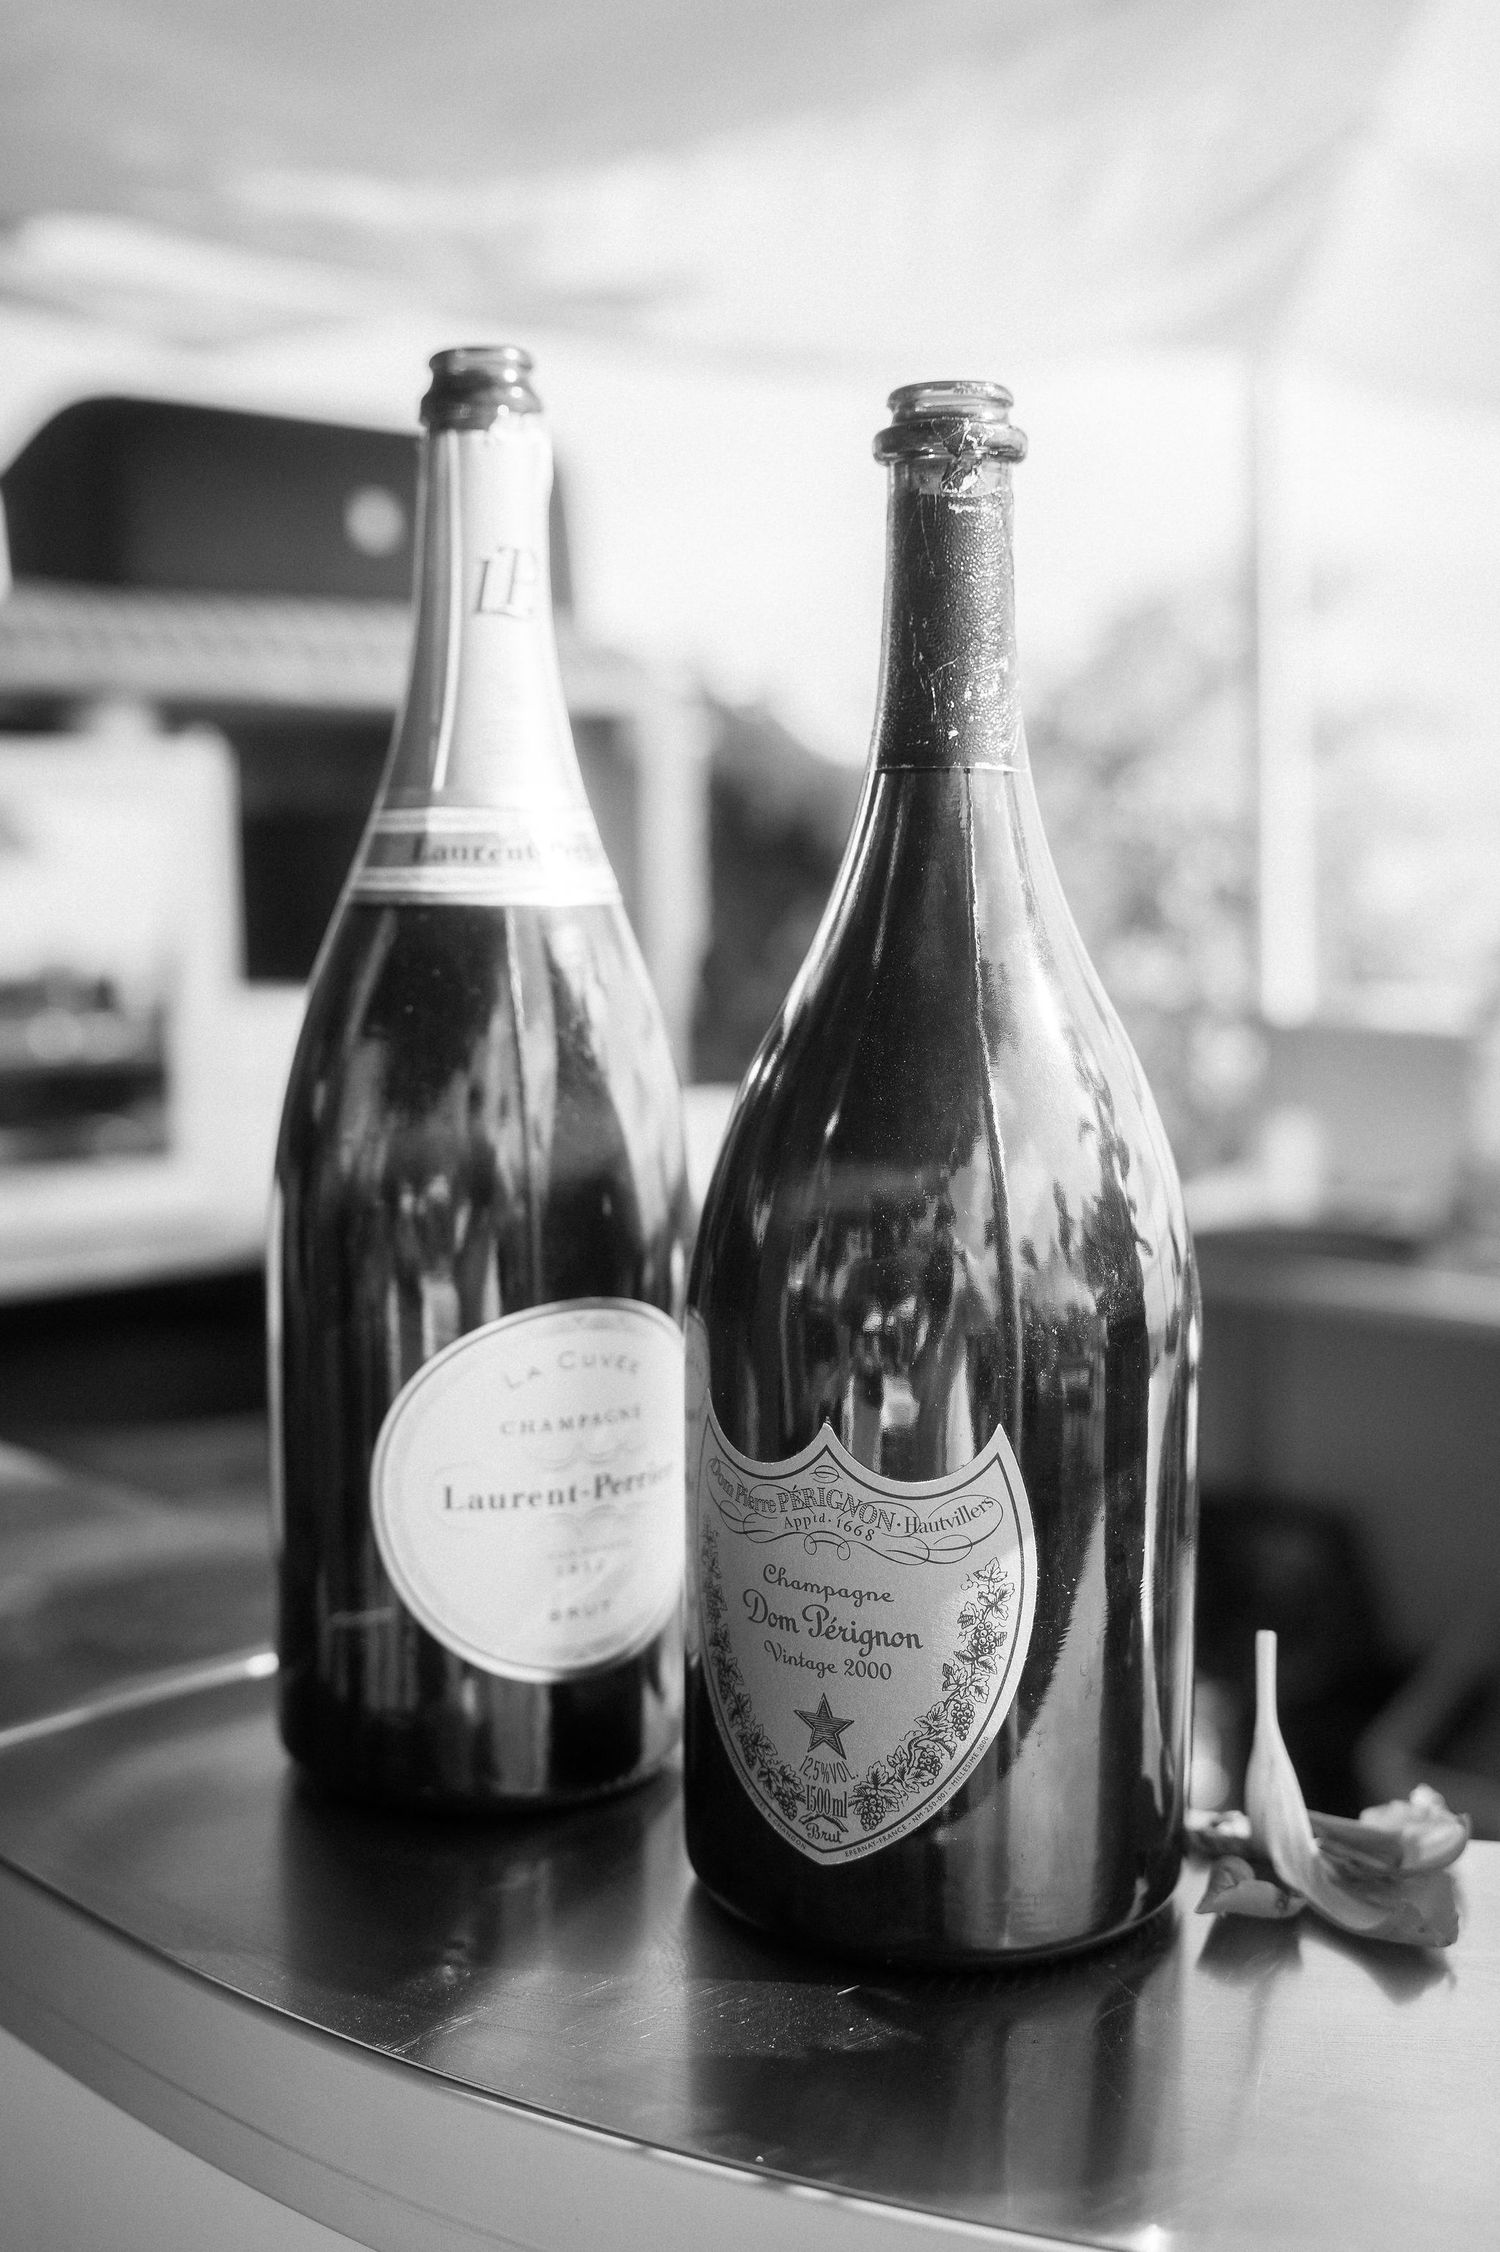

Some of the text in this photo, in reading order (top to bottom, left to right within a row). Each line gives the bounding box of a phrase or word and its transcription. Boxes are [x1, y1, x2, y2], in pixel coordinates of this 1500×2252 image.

[836, 1518, 875, 1542] 1668
[762, 1563, 895, 1607] Champagne
[743, 1588, 924, 1657] Dom Pérignon
[763, 1640, 893, 1680] Vintage 2000
[805, 1822, 842, 1844] Brut
